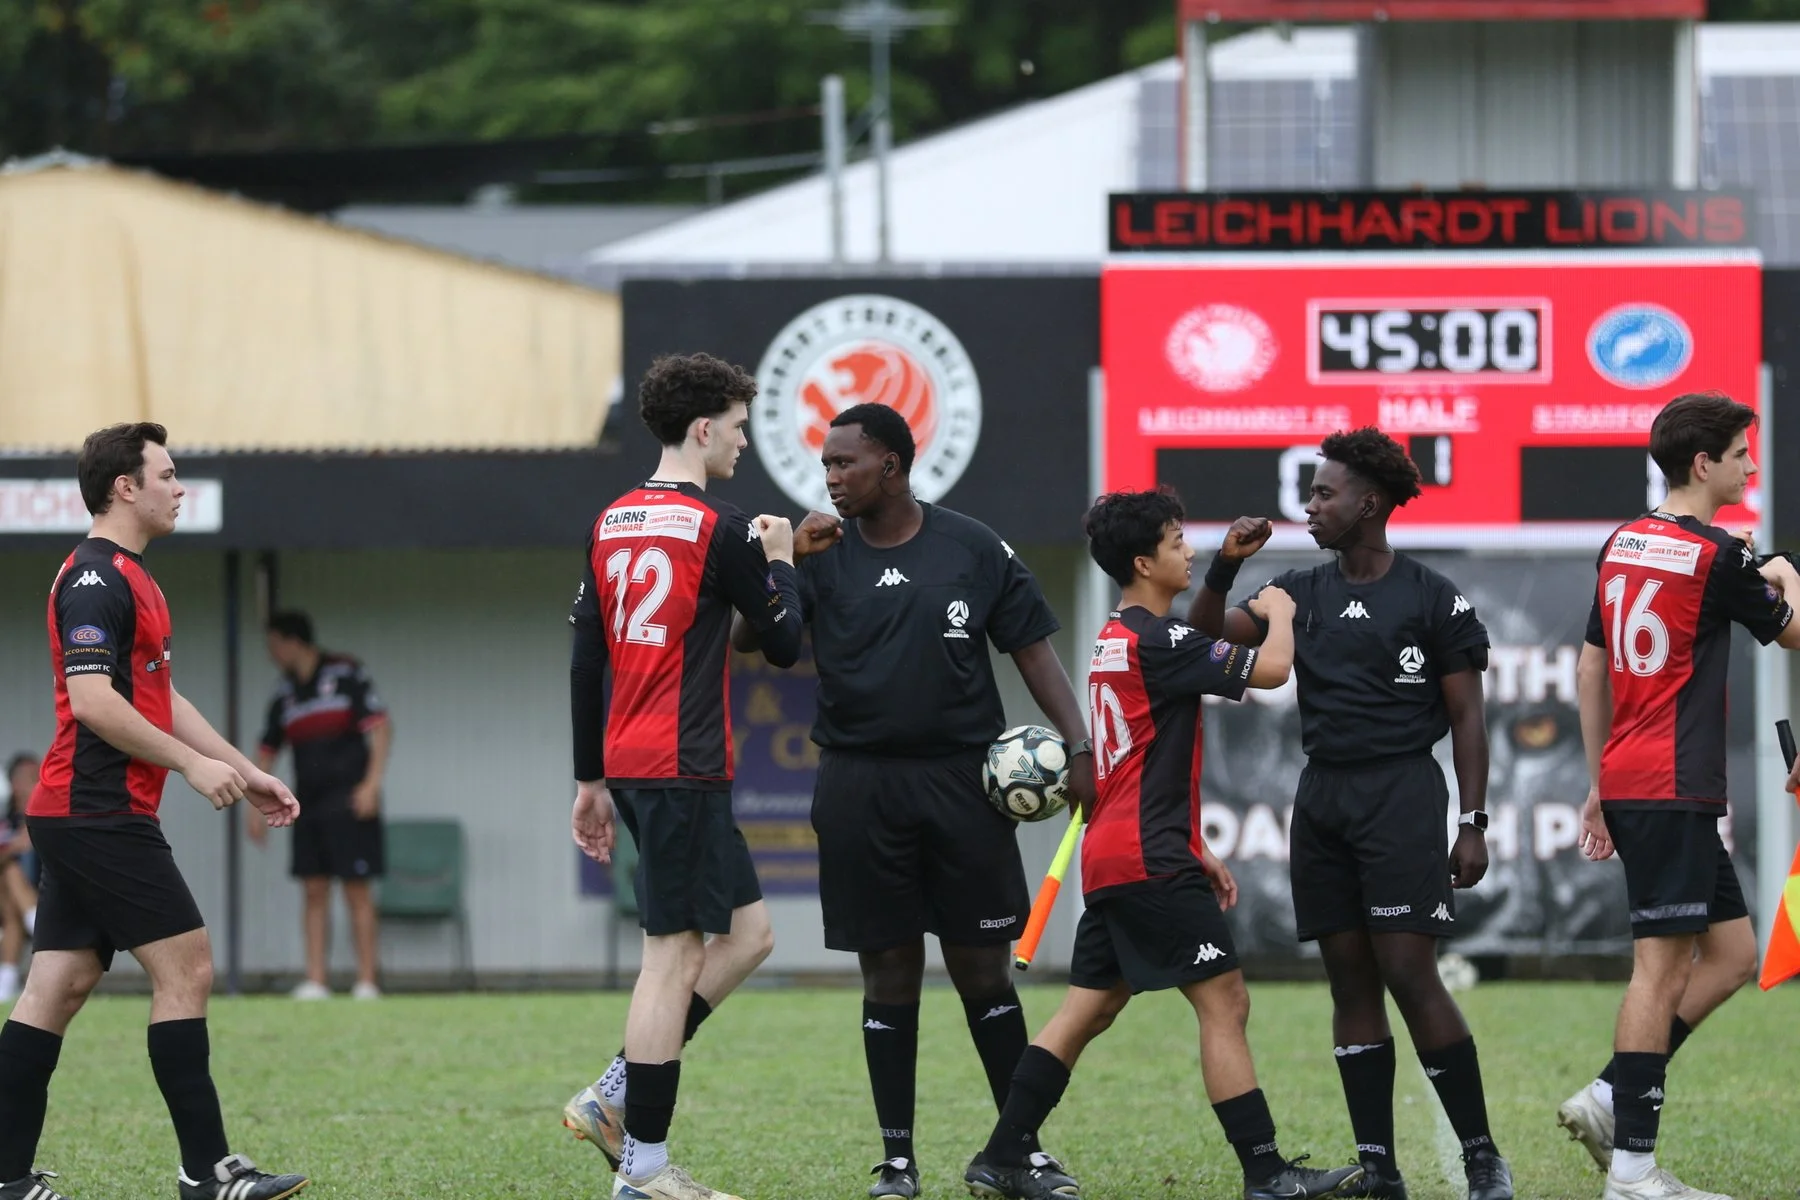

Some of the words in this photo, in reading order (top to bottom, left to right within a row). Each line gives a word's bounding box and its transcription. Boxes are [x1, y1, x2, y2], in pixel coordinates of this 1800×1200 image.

[1116, 199, 1529, 244] LEICHHARDT
[1544, 198, 1745, 243] LIONS
[1321, 309, 1537, 373] 45:00
[605, 510, 647, 526] CAIRNS
[676, 515, 692, 524] DONE
[604, 523, 644, 535] HARDWARE
[1614, 536, 1648, 551] CAIRNS
[1610, 549, 1642, 560] HARDWARE
[1673, 550, 1690, 558] DONE
[606, 547, 673, 647] 12
[1605, 574, 1669, 677] 16
[77, 631, 98, 640] GCG
[65, 647, 111, 656] ACCOUNTANTS
[1371, 905, 1411, 917] Kappa
[980, 915, 1016, 928] Kappa
[1252, 1142, 1277, 1155] Kap
